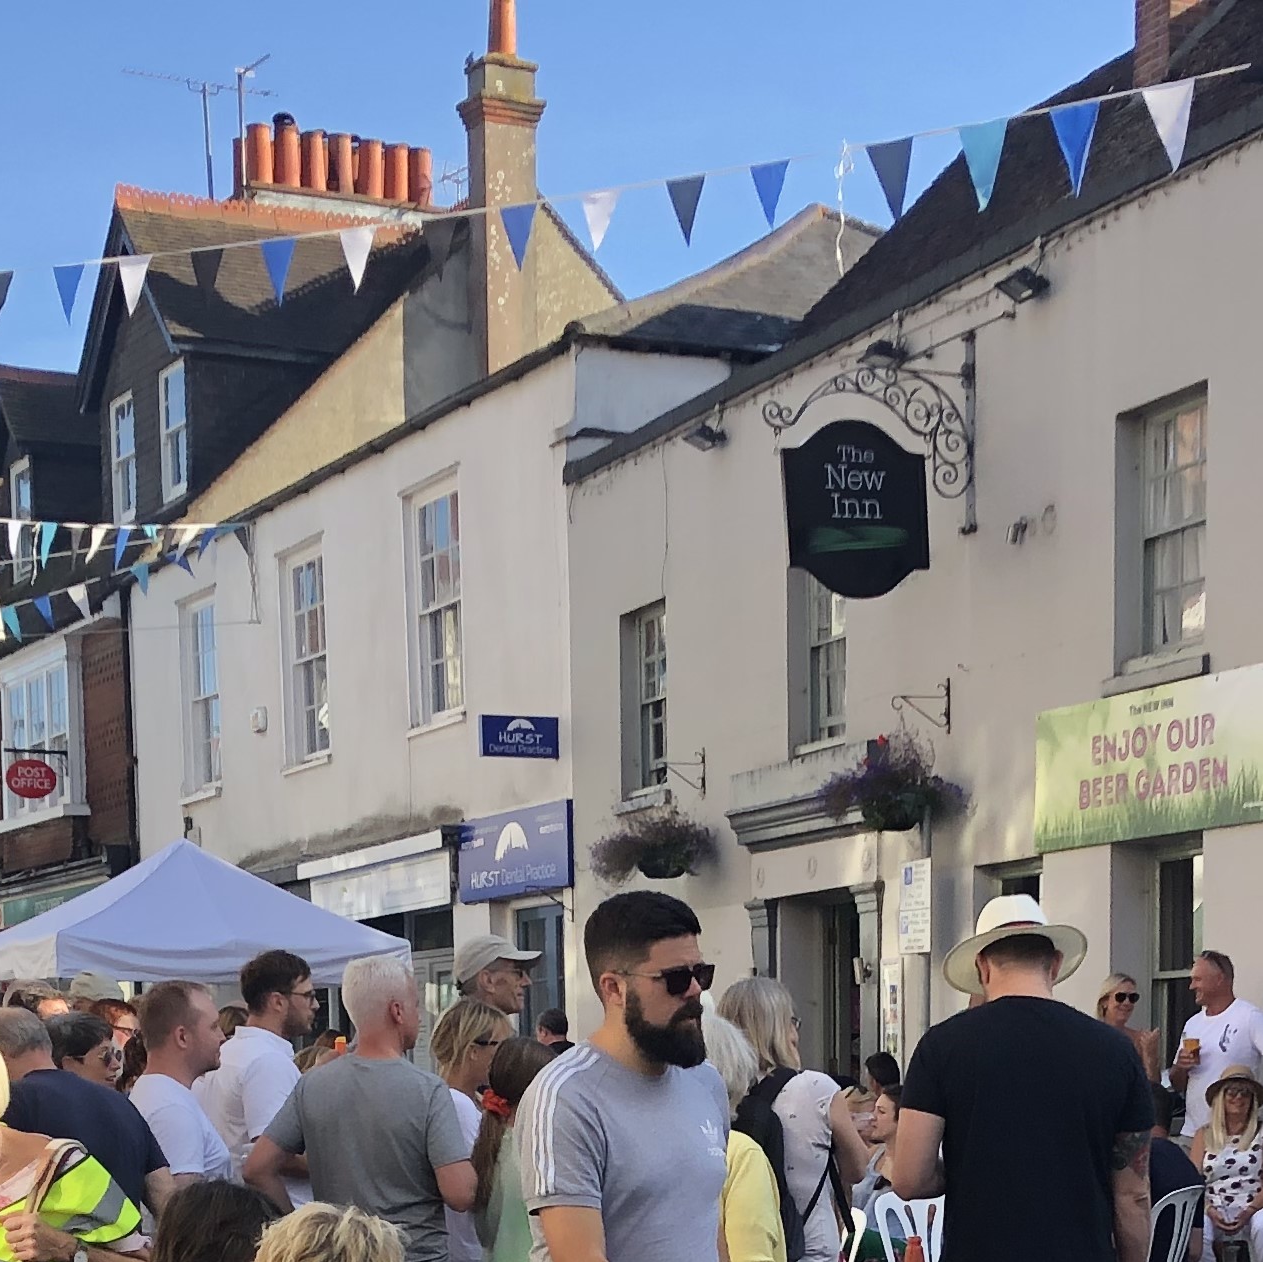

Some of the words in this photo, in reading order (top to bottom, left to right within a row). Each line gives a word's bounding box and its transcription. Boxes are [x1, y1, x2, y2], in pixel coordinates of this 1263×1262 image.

[837, 444, 874, 463] The
[824, 463, 886, 491] New
[831, 492, 883, 519] Inn
[498, 731, 543, 744] HURST
[1092, 723, 1161, 766] ENJOY
[1166, 713, 1215, 752] OUR
[18, 766, 46, 778] POST
[11, 777, 51, 789] OFFICE
[1079, 772, 1129, 810] BEER
[1135, 755, 1228, 801] GARDEN
[471, 870, 500, 889] HURST
